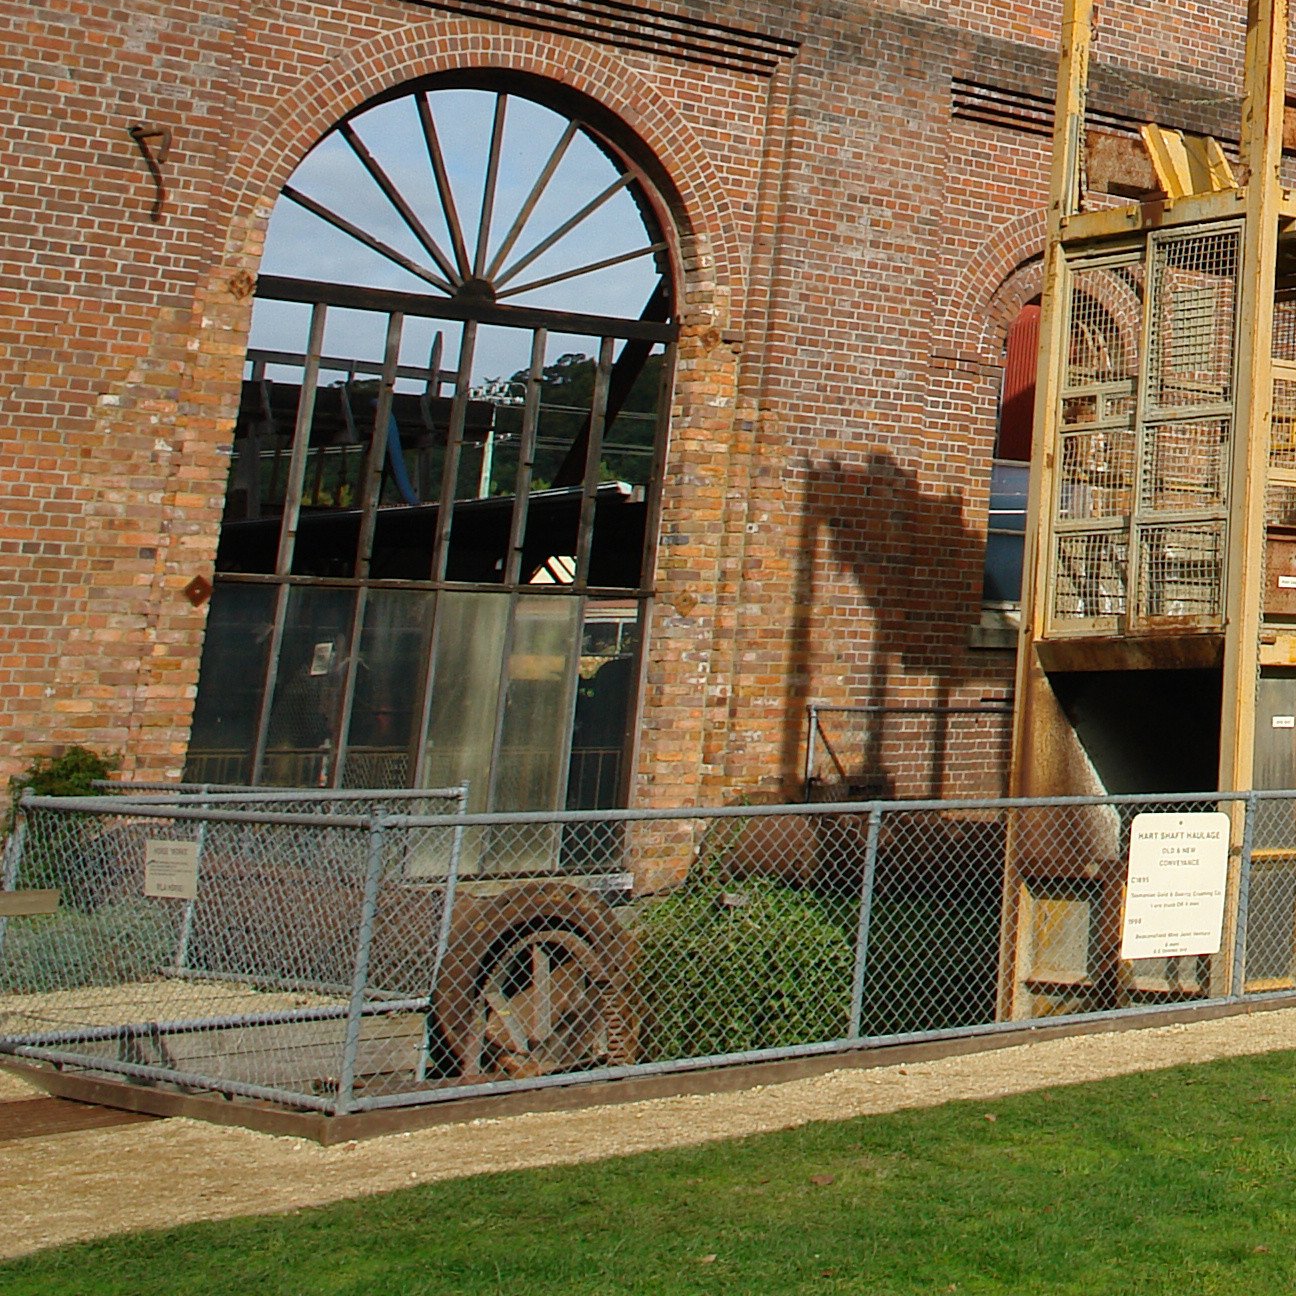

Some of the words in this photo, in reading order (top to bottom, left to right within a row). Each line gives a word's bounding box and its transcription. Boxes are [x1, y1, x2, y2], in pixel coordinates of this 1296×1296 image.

[1138, 832, 1159, 840] HART
[1160, 831, 1184, 840] SHAFT
[1186, 831, 1221, 840] HAULAGE
[1161, 847, 1175, 855] OLD
[1159, 858, 1200, 867] CONVEYANCE
